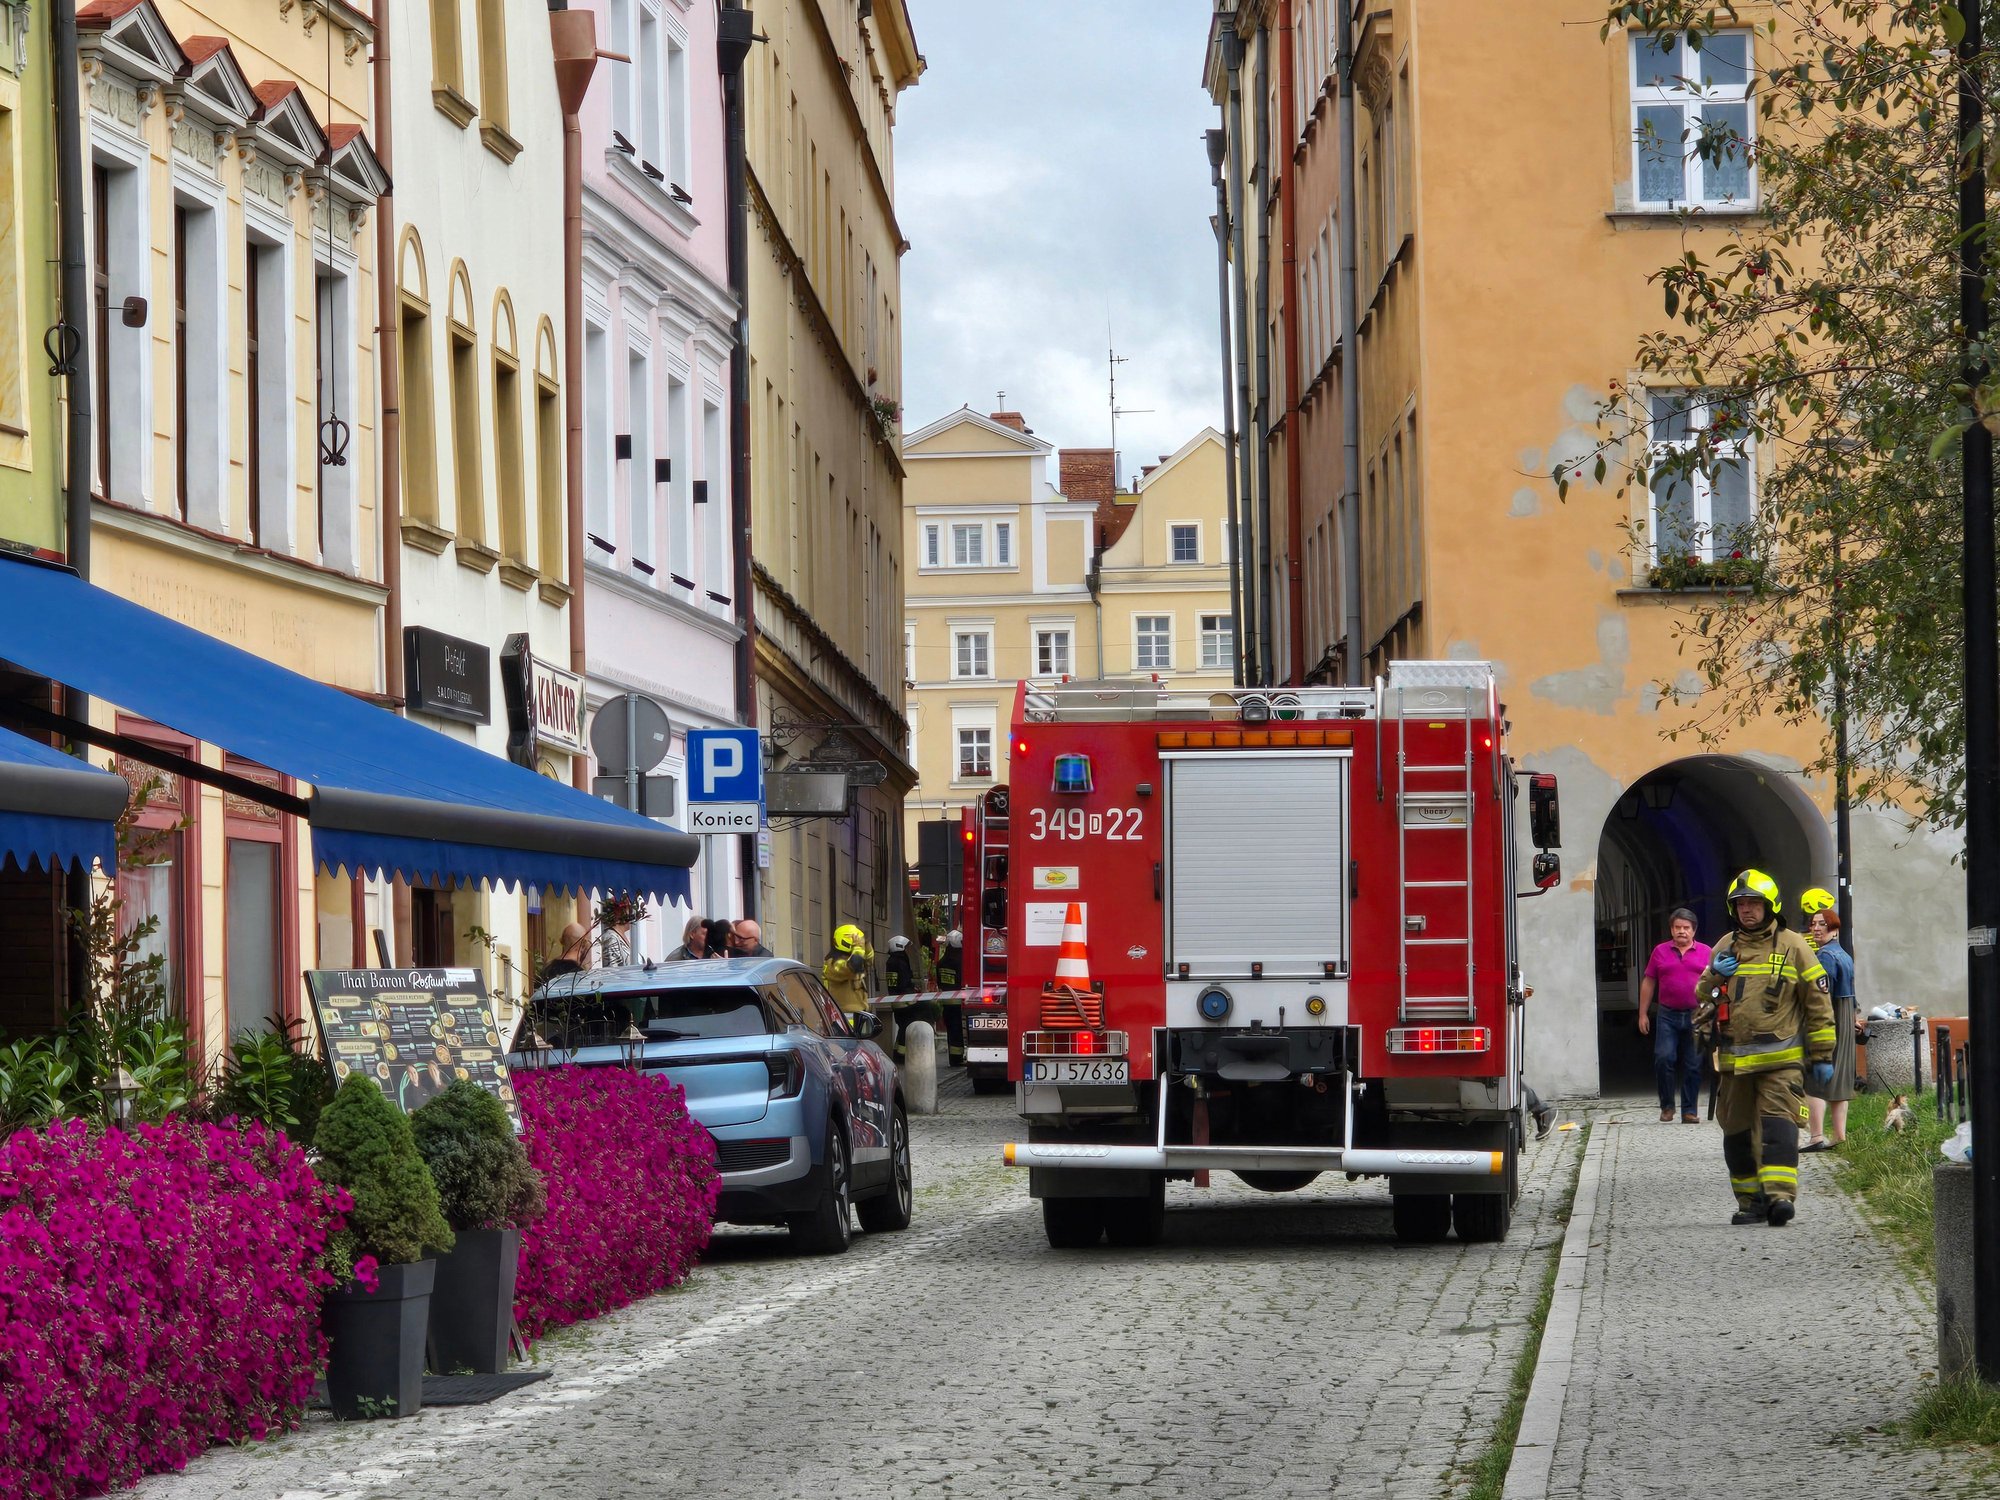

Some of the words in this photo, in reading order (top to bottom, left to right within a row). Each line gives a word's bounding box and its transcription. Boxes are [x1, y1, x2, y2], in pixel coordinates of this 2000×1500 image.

[538, 675, 577, 736] KANTOR
[702, 737, 743, 794] P
[693, 811, 753, 827] Koniec
[1029, 807, 1085, 841] 349
[1106, 807, 1143, 841] 22
[337, 970, 367, 989] Thai
[370, 971, 407, 989] Baron
[973, 1019, 993, 1028] DJE
[1035, 1063, 1059, 1081] DJ
[1068, 1062, 1125, 1081] 57636
